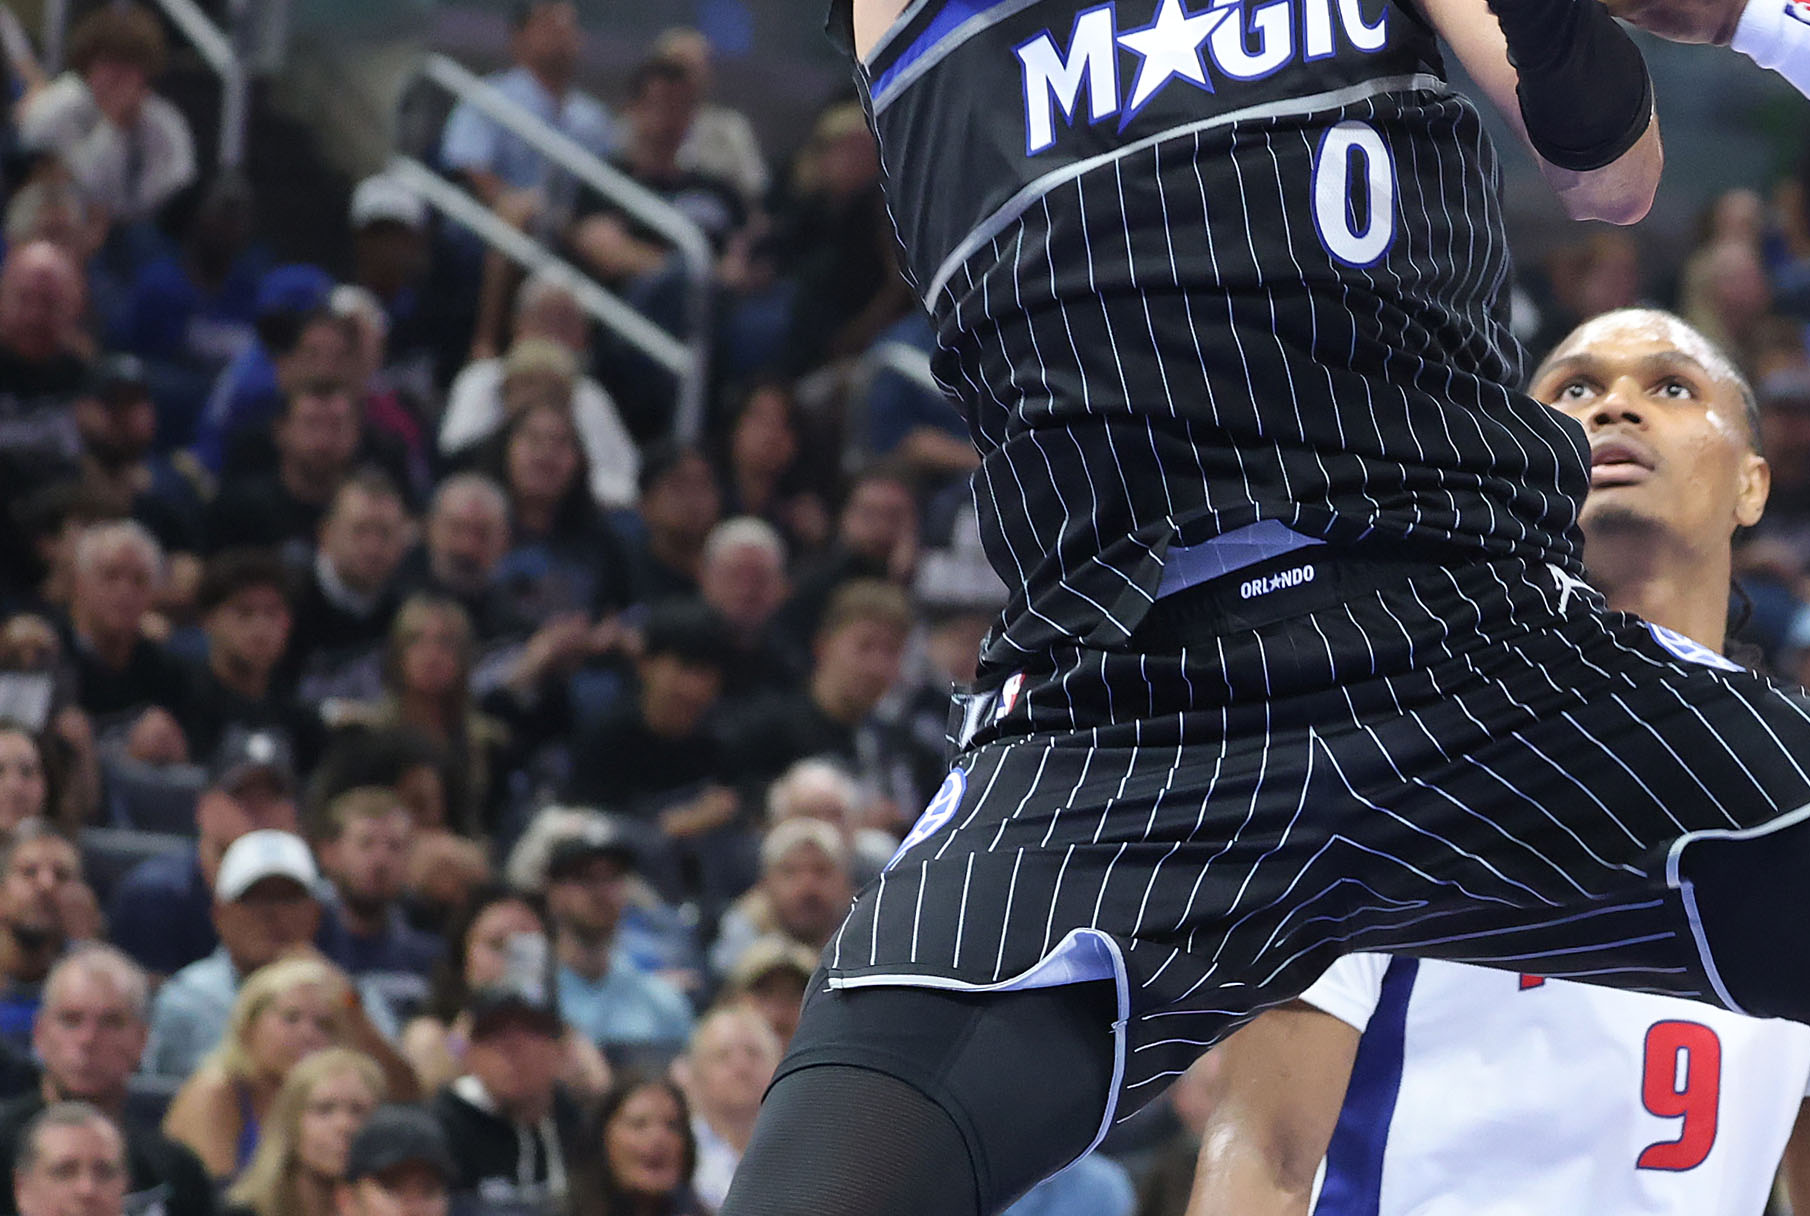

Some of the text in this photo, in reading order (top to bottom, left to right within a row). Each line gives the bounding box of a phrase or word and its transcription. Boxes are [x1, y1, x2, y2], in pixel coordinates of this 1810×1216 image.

[1311, 119, 1398, 269] 0
[1240, 564, 1315, 600] ORLANDO
[1636, 1019, 1722, 1173] 9
